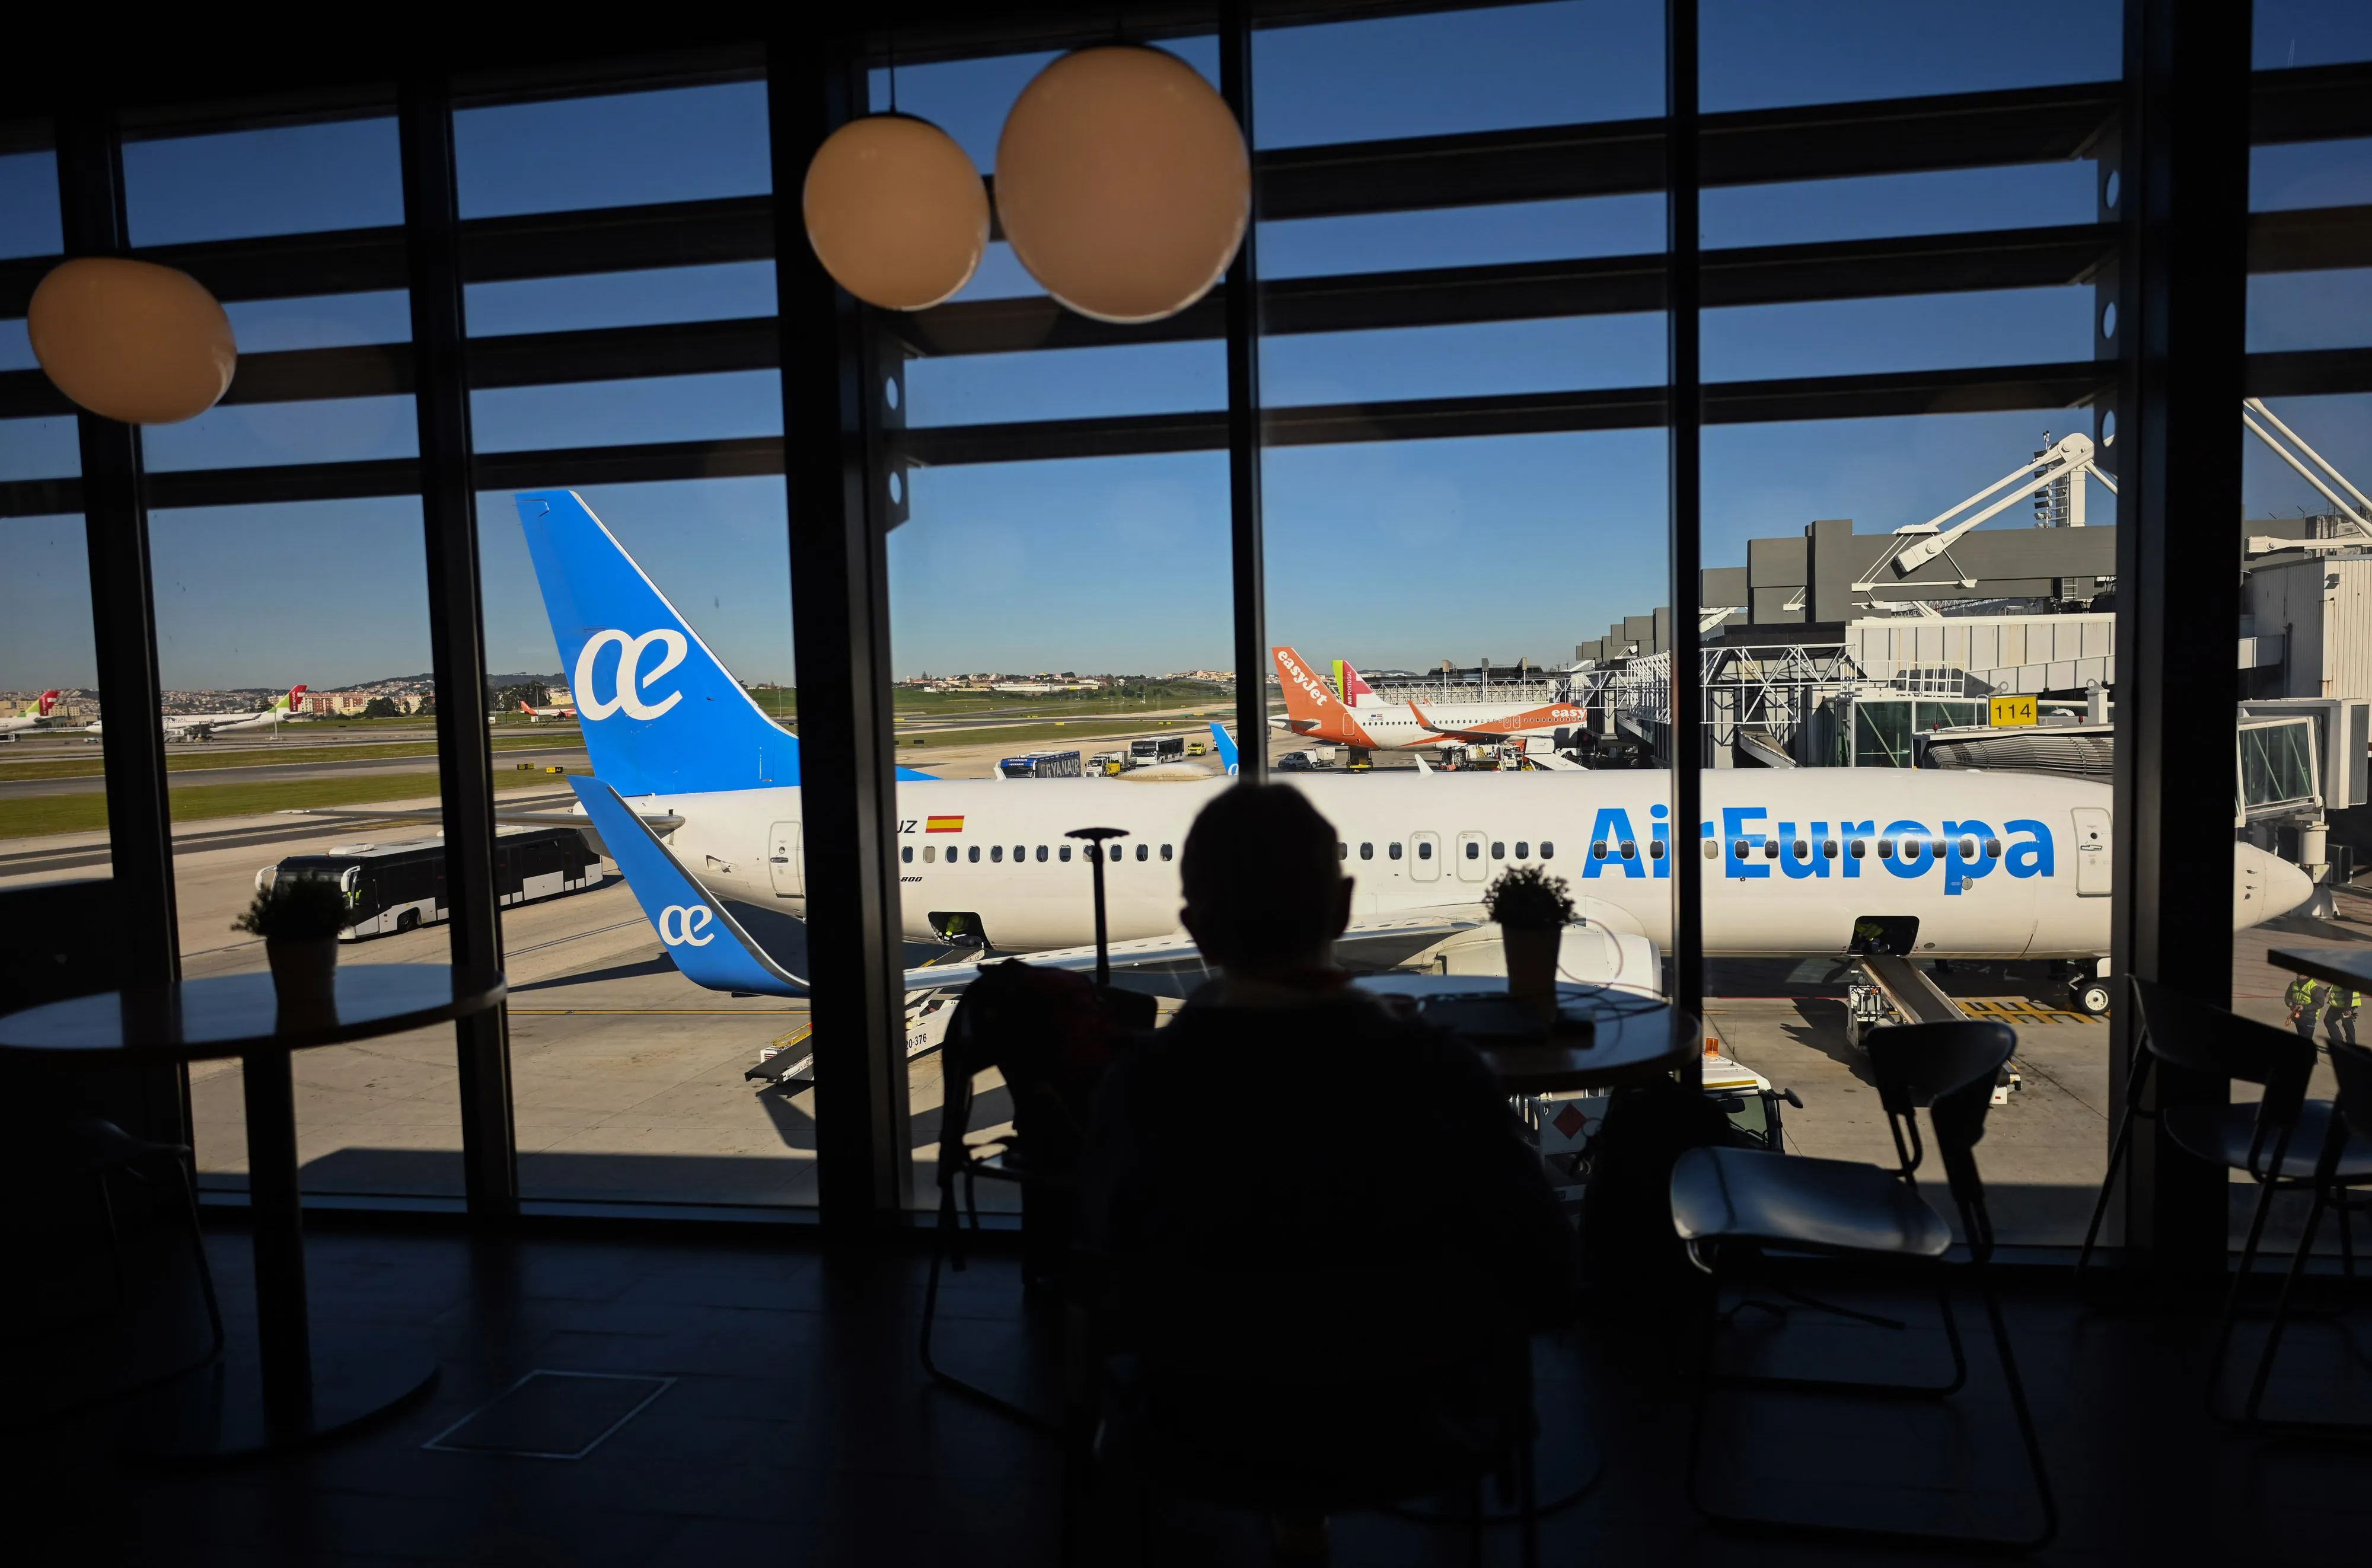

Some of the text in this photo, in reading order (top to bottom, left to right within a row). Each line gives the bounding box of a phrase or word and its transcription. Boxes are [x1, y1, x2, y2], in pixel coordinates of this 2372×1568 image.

[1278, 651, 1328, 706] easyJet
[1551, 709, 1587, 719] easy
[1995, 703, 2032, 720] 114
[1046, 758, 1080, 778] RYANAIR
